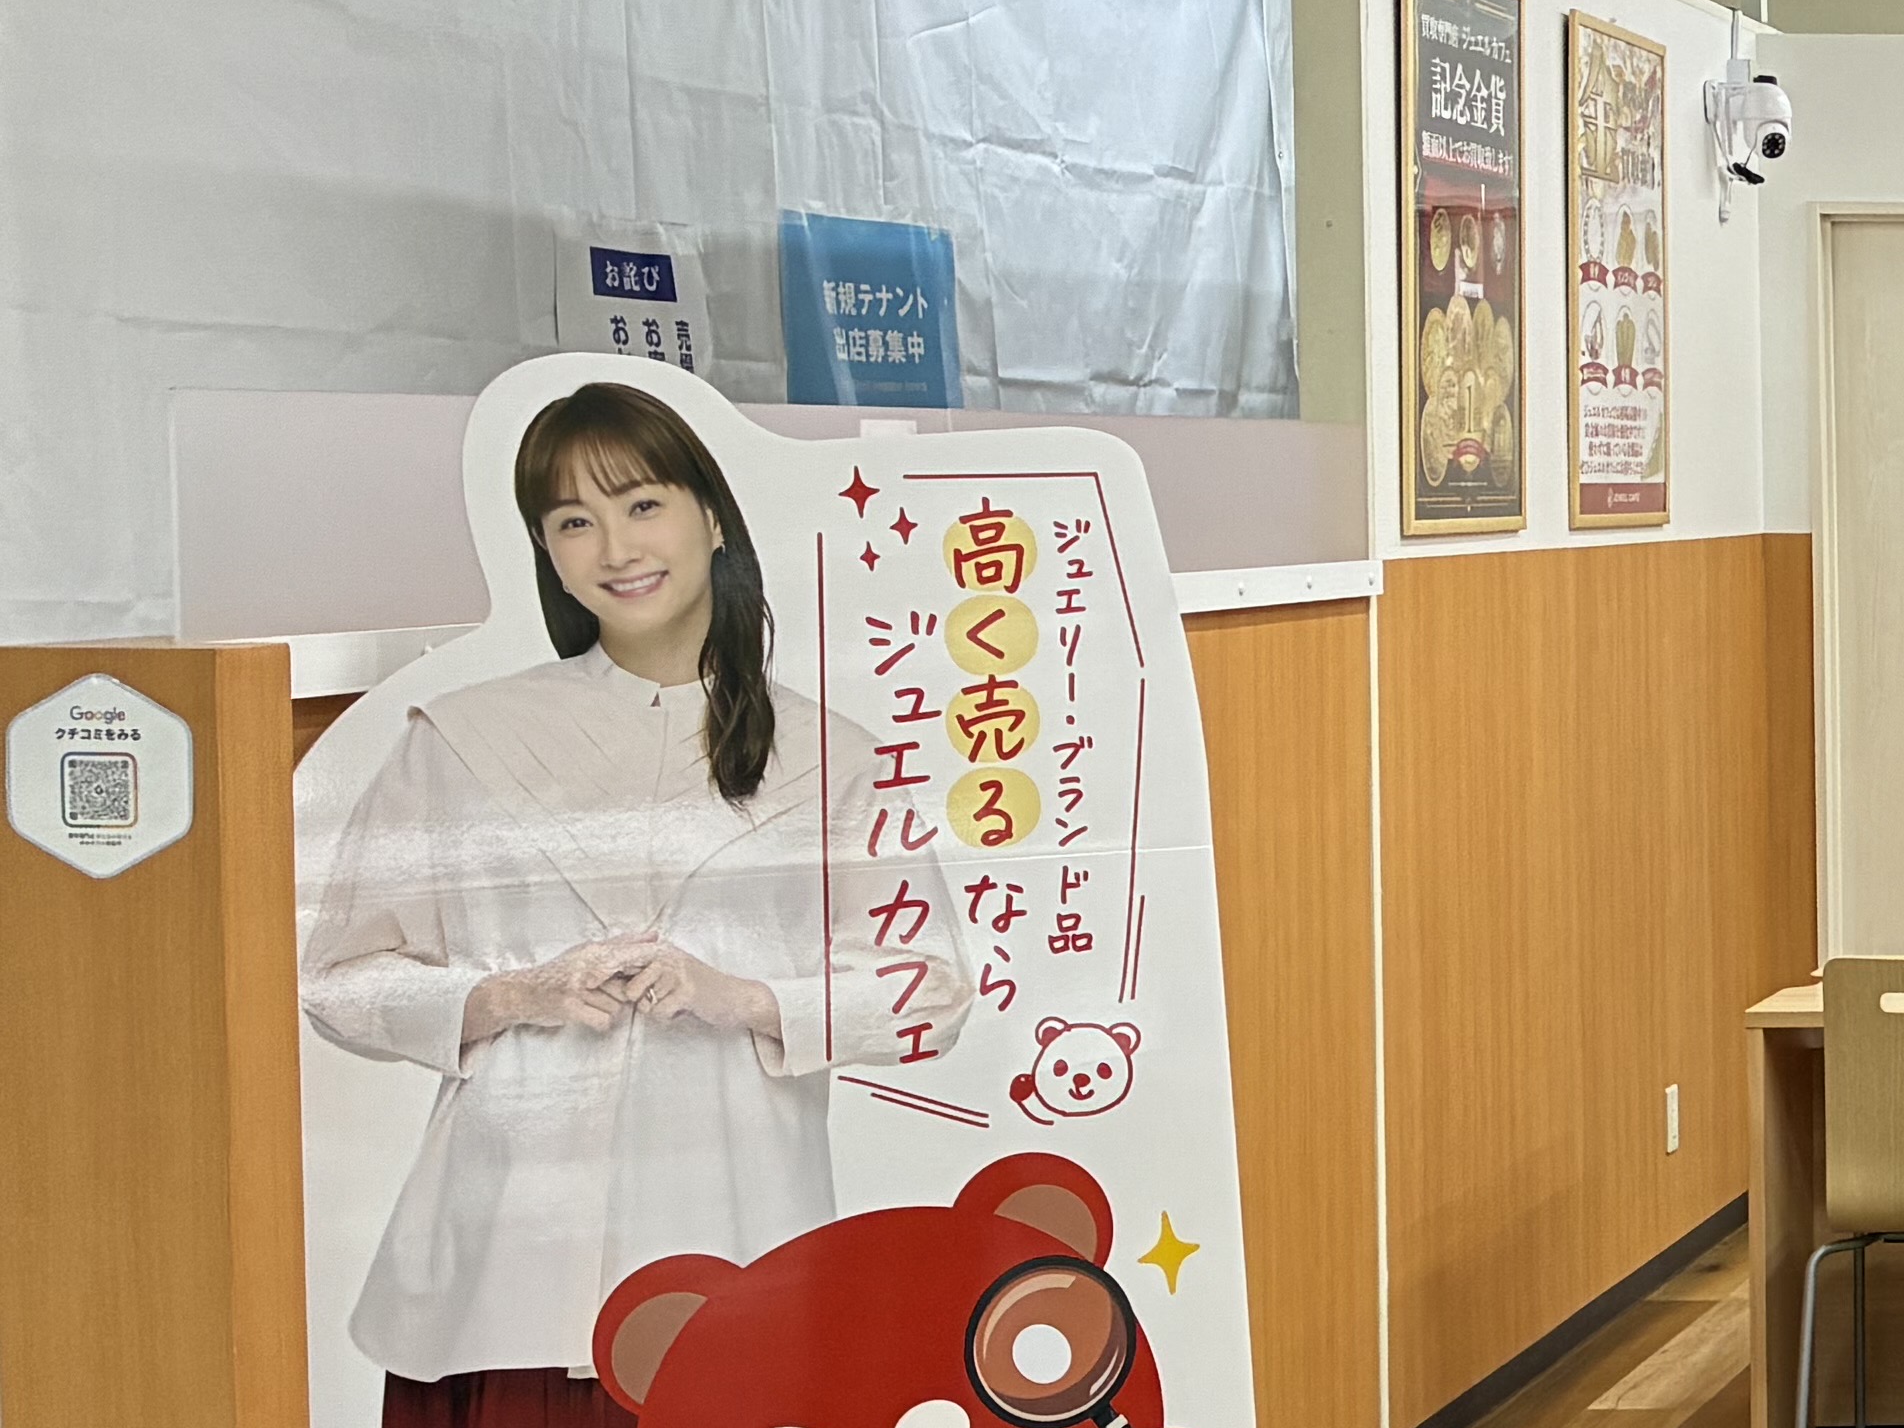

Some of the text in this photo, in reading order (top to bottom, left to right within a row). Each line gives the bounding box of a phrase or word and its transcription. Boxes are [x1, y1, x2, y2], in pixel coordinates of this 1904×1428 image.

[1430, 56, 1506, 137] 記念金貨
[605, 260, 660, 291] お詫び
[822, 279, 928, 319] 新規テナント
[833, 326, 925, 364] 出店募集中
[54, 727, 142, 741] クチコミをみる
[70, 706, 126, 725] Google
[954, 496, 1028, 1011] 高く売るなら
[1048, 518, 1094, 954] ジュエリー・ブランド品
[864, 610, 942, 1065] ジュエルカフェ
